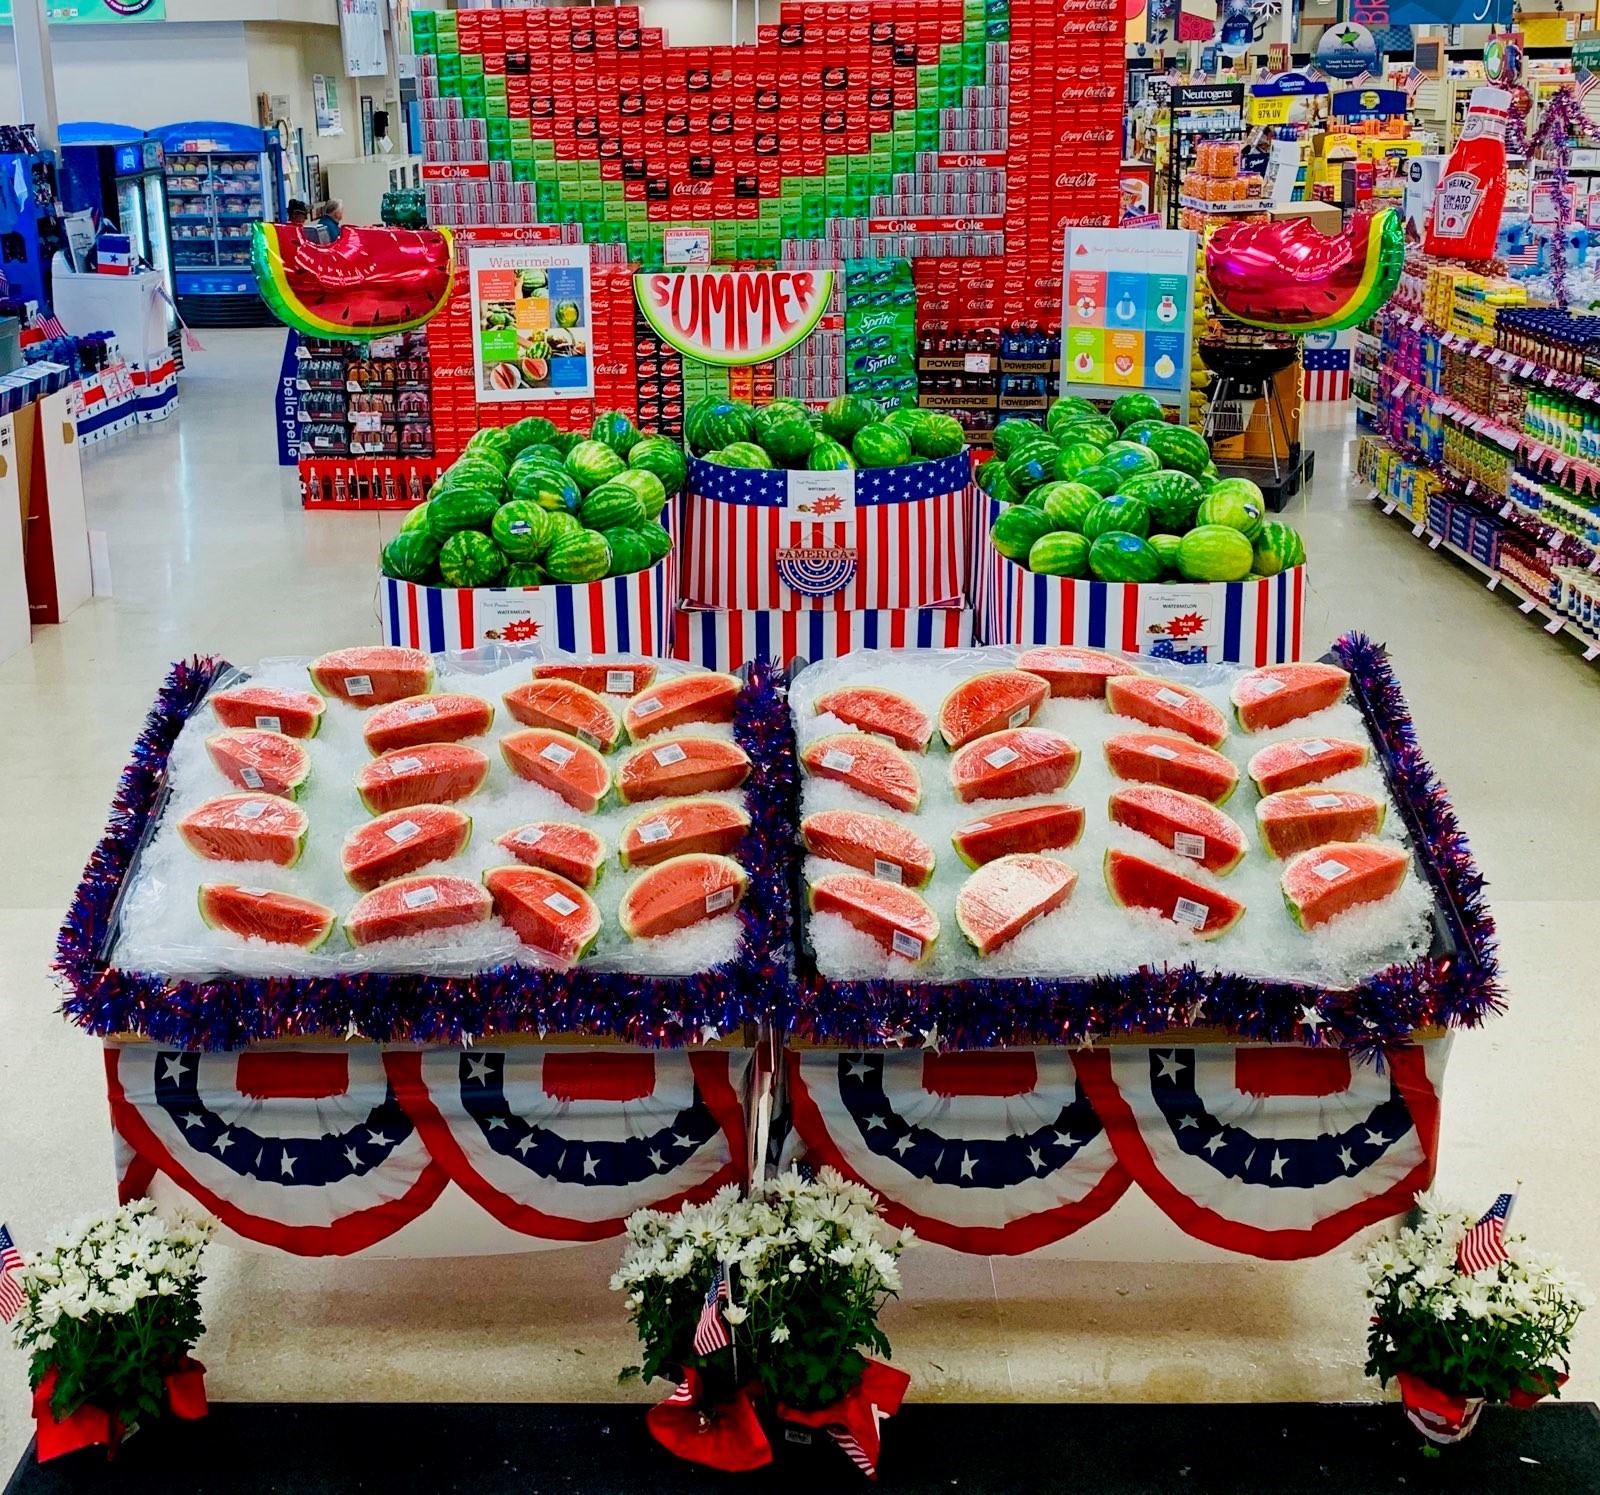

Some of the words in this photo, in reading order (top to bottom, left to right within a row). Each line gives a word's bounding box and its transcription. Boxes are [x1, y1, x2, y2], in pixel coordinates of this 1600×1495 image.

[1063, 21, 1085, 32] Enjoy
[1062, 87, 1084, 98] Enjoy
[1182, 89, 1233, 100] Neutrogena
[1060, 130, 1082, 142] Enjoy
[957, 156, 986, 166] Coke
[442, 166, 470, 178] Coke
[1448, 180, 1472, 189] HEINZ
[1444, 195, 1471, 204] TOMATO
[1444, 202, 1468, 210] KETCHUP
[888, 222, 916, 232] Coke
[955, 220, 984, 230] Coke
[1058, 216, 1079, 227] Enjoy
[514, 229, 542, 240] Coke
[490, 256, 570, 268] Watermelon
[651, 272, 816, 350] SUMMER
[861, 314, 894, 330] Sprite
[867, 354, 897, 373] Sprite
[926, 360, 965, 368] POWER
[434, 366, 454, 377] Enjoy
[283, 377, 298, 416] bella
[282, 420, 300, 457] pelle
[785, 550, 848, 558] AMERICA
